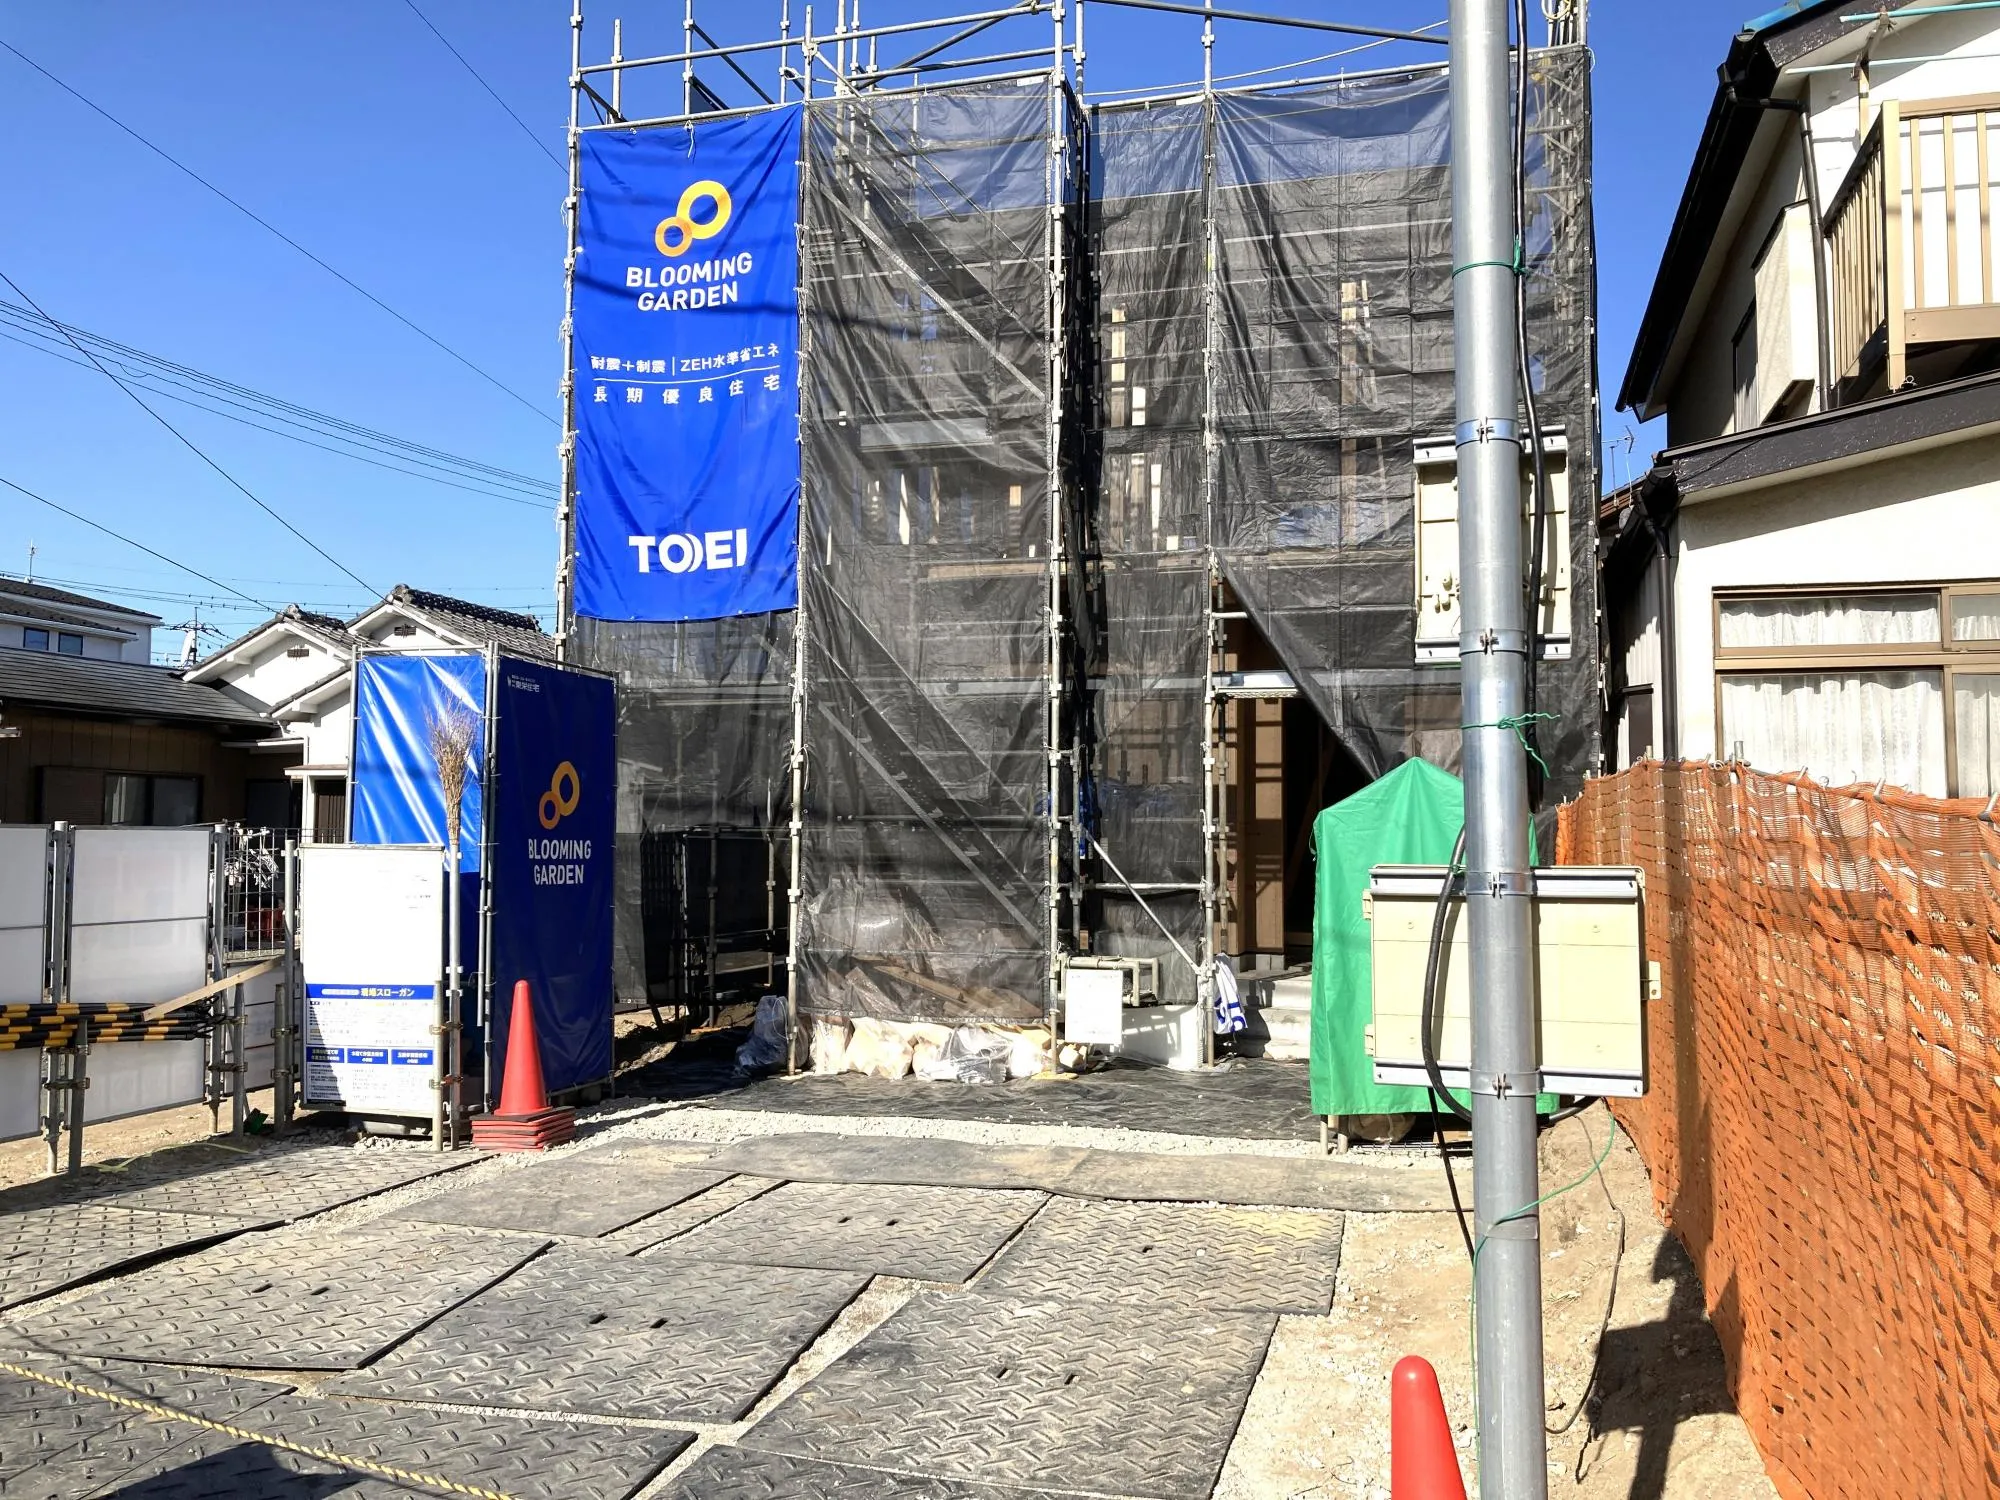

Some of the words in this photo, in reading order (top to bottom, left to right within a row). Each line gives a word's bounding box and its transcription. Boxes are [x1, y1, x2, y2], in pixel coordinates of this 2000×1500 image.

[626, 252, 753, 288] BLOOMING
[637, 281, 738, 311] GARDEN
[680, 343, 780, 372] ZEH水準省エネ
[593, 374, 780, 405] 長期優良住宅
[628, 528, 748, 574] TOEI
[528, 838, 592, 860] BLOOMING
[533, 864, 584, 885] GARDEN
